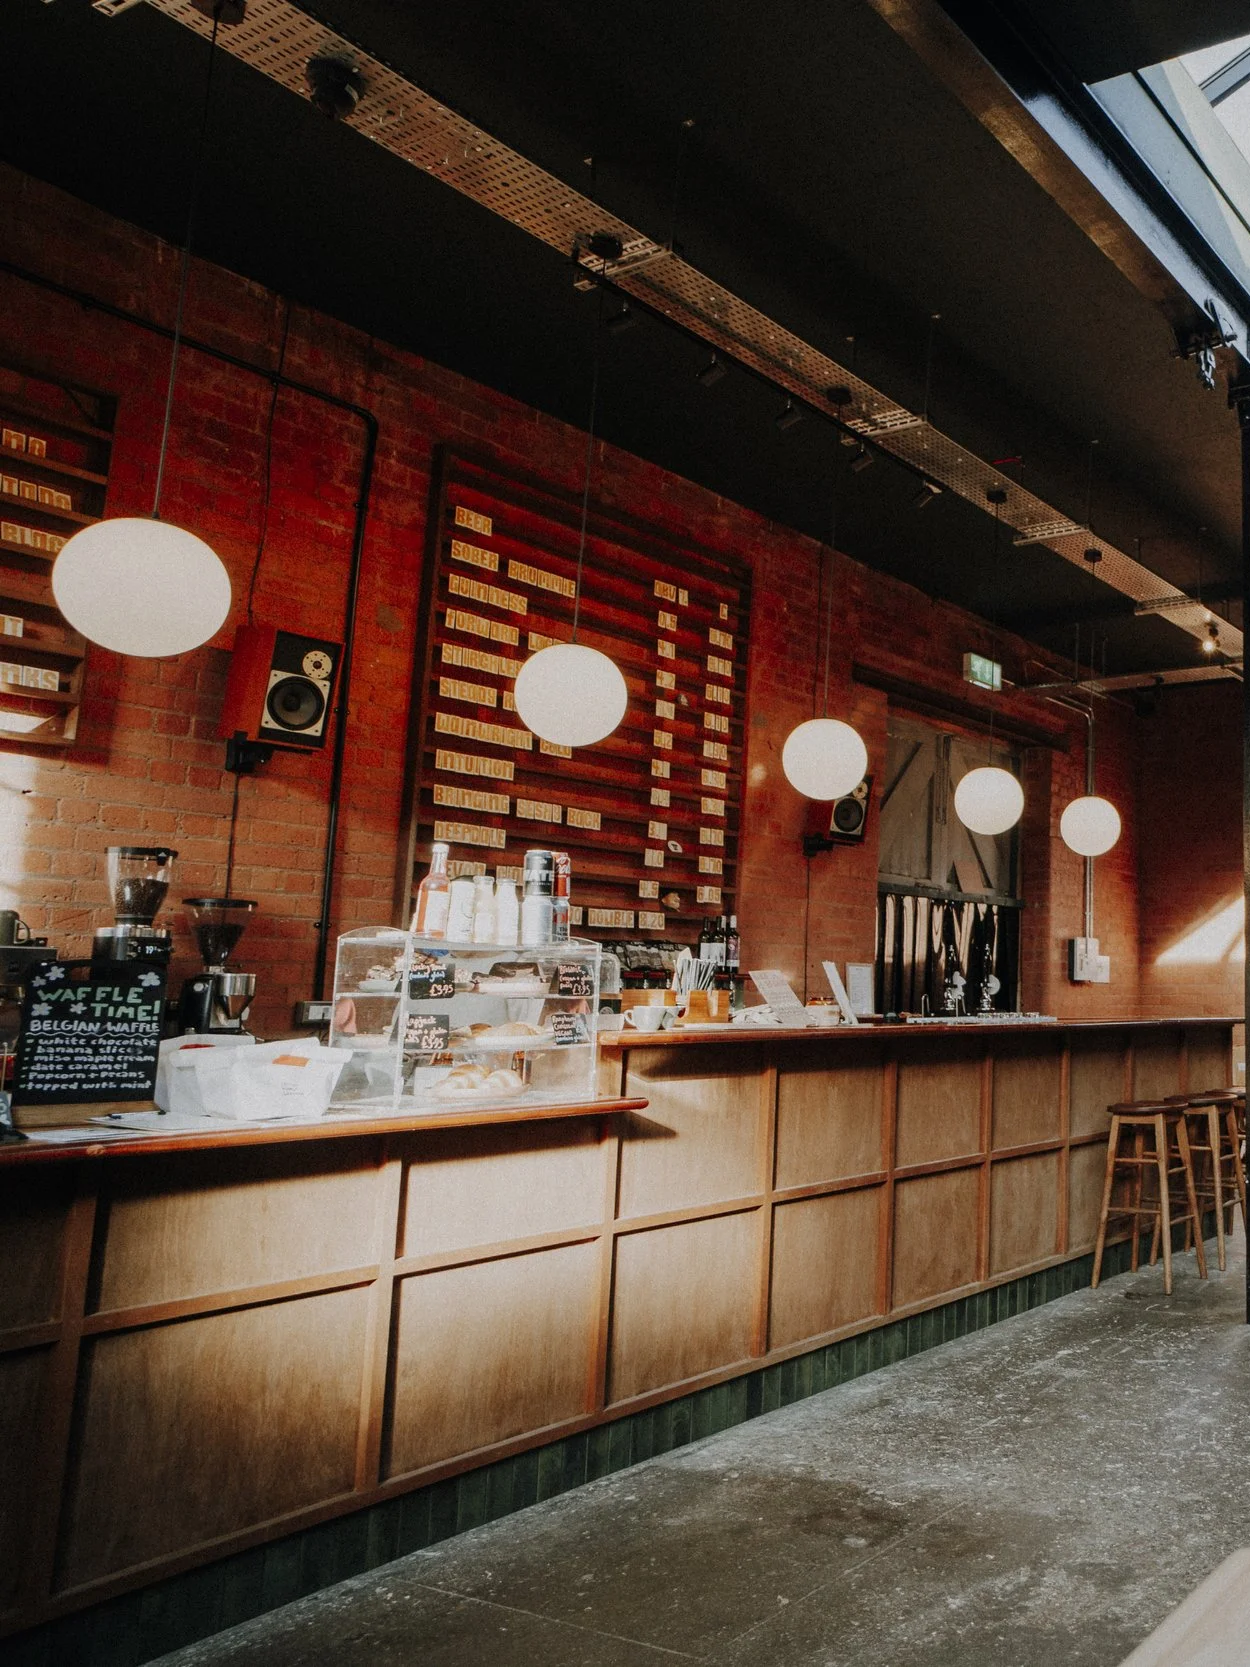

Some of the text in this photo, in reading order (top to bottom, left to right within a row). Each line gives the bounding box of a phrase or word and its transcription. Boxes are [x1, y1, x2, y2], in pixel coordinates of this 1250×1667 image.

[456, 507, 491, 535] BEER
[452, 541, 498, 571] SOBER
[509, 560, 575, 597] BRUMMIE
[449, 574, 527, 614] GUINNESS
[436, 750, 513, 780] INTUITION
[434, 785, 509, 813] BRINGING
[589, 910, 633, 927] DOUBLE
[37, 987, 143, 1003] WAFFLE
[91, 1000, 160, 1021] TIME!
[30, 1020, 160, 1033] BELGIAN WAFFLE
[36, 1046, 93, 1054] banana
[39, 1037, 157, 1046] white chocolate
[34, 1054, 71, 1062] miso
[74, 1055, 114, 1063] maple
[120, 1081, 152, 1089] mint
